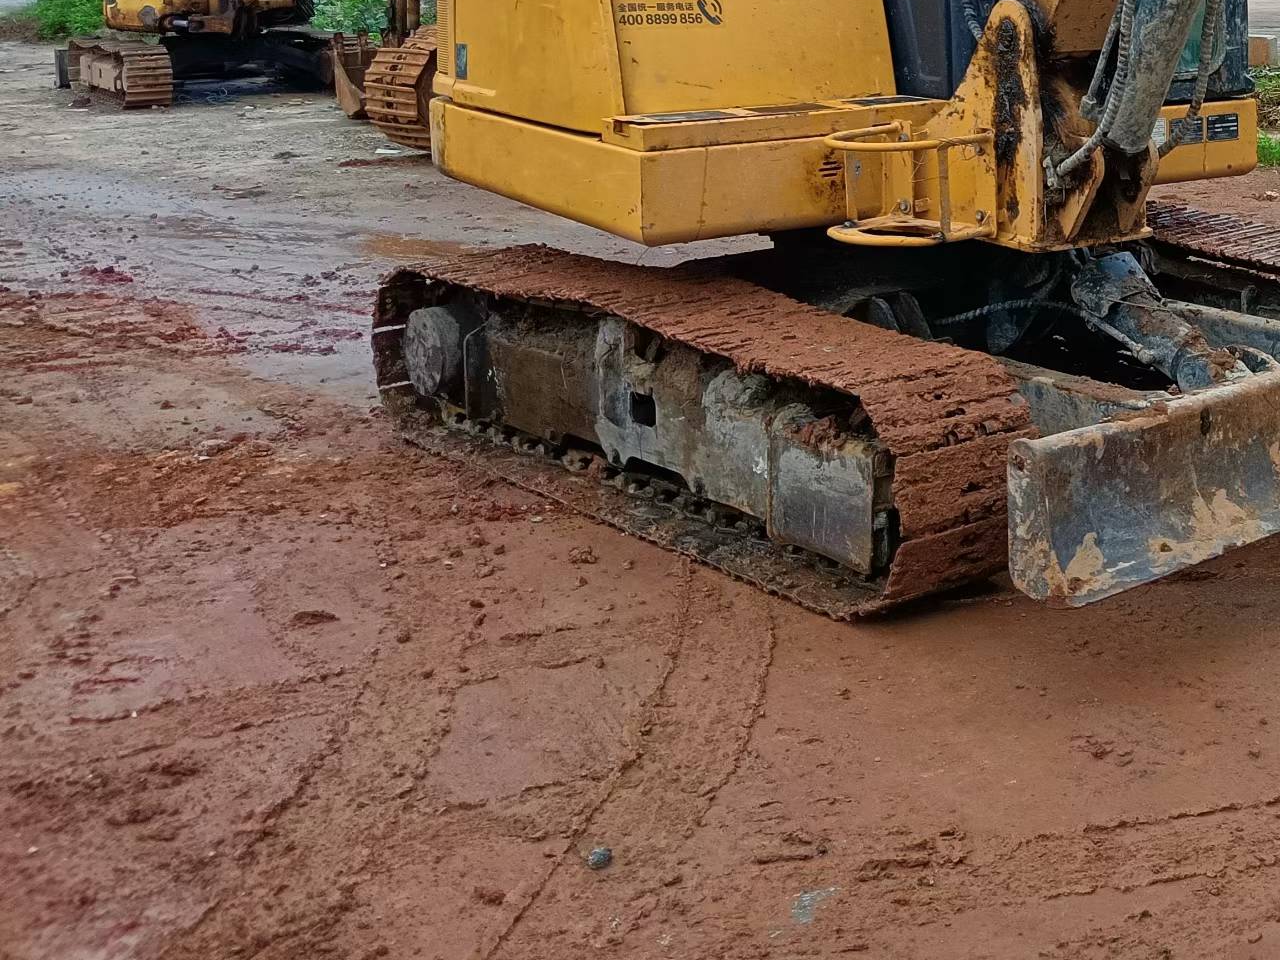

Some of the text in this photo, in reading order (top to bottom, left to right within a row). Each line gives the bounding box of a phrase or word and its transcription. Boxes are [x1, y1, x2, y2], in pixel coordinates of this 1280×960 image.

[617, 2, 694, 13] 全国统一服务电话
[618, 12, 703, 26] 400 8899 856
